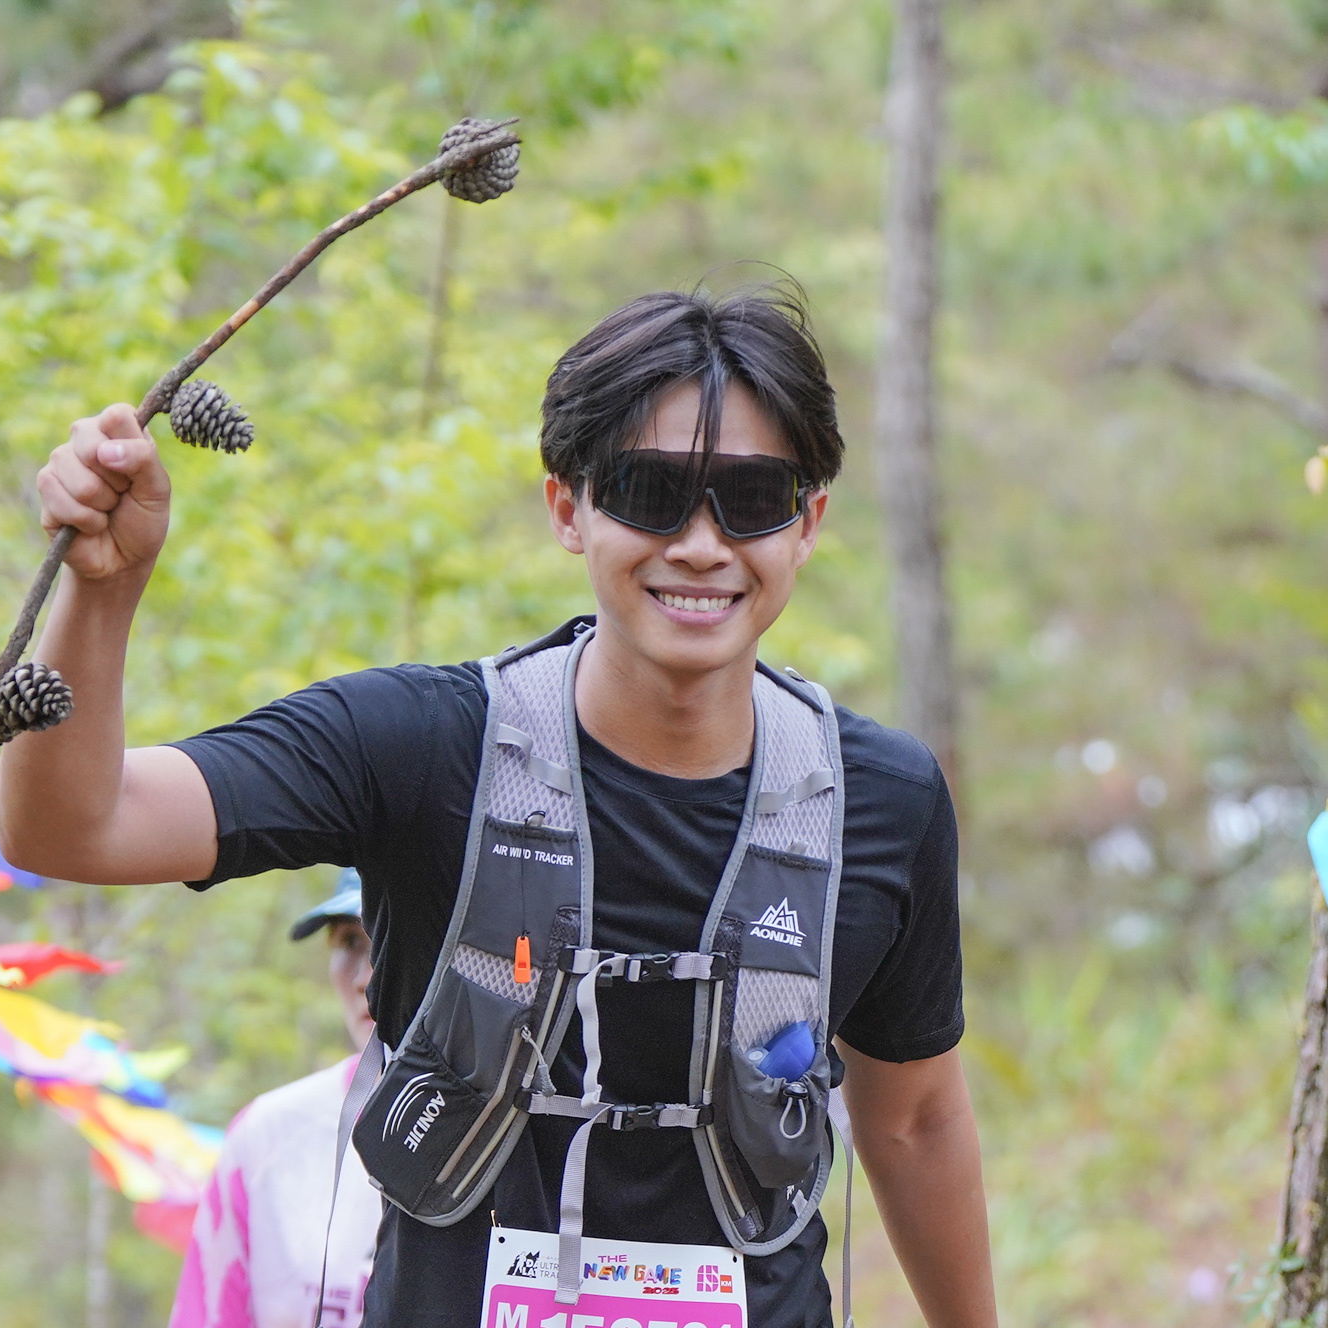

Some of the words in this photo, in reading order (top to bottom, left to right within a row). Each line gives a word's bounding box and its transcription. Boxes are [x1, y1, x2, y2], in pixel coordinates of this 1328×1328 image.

[492, 843, 509, 857] AIR
[534, 850, 574, 866] TRACKER
[749, 926, 804, 947] AONIJIE
[403, 1090, 446, 1153] AONIJIE
[540, 1262, 559, 1270] ULTR
[598, 1254, 628, 1263] THE
[540, 1270, 559, 1279] TRA
[583, 1262, 630, 1282] NEW
[633, 1264, 682, 1286] GAME
[642, 1286, 680, 1295] 2025
